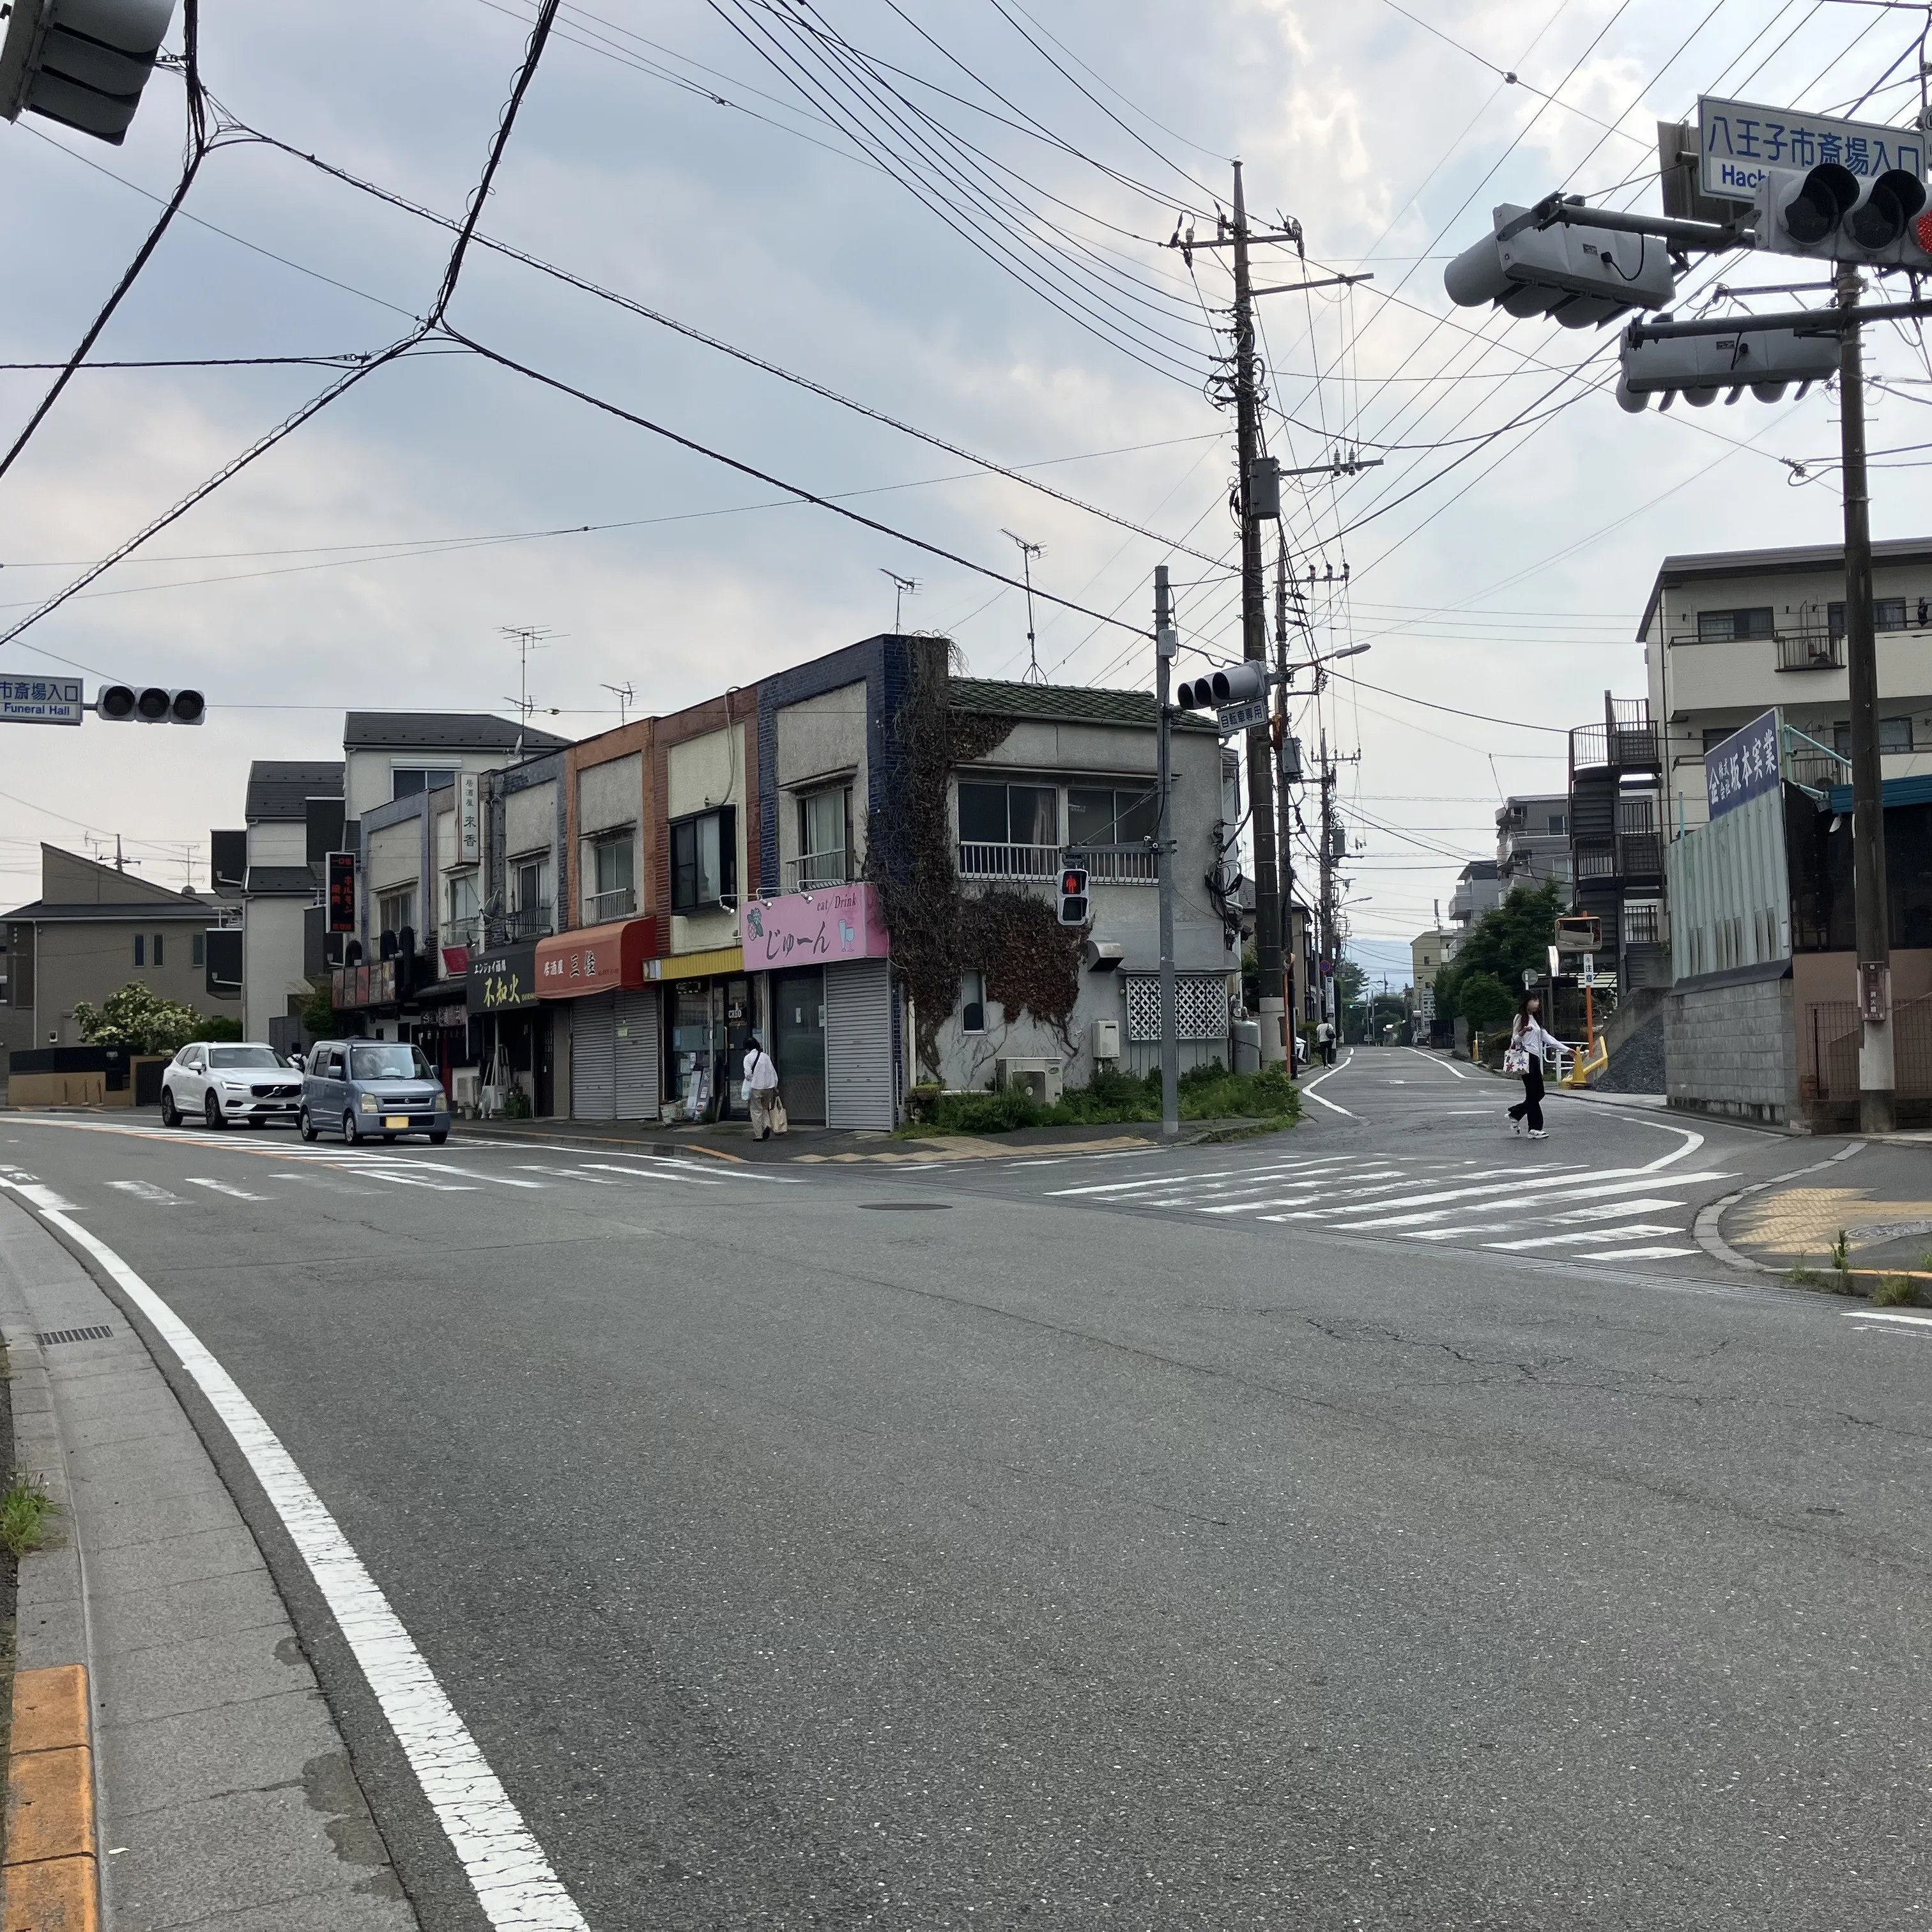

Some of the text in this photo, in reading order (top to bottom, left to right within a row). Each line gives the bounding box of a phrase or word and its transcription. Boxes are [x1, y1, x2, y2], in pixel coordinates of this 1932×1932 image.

[4, 702, 70, 716] Funeral Hall
[1221, 705, 1262, 728] 自転車専用
[766, 921, 831, 960] じゅーん
